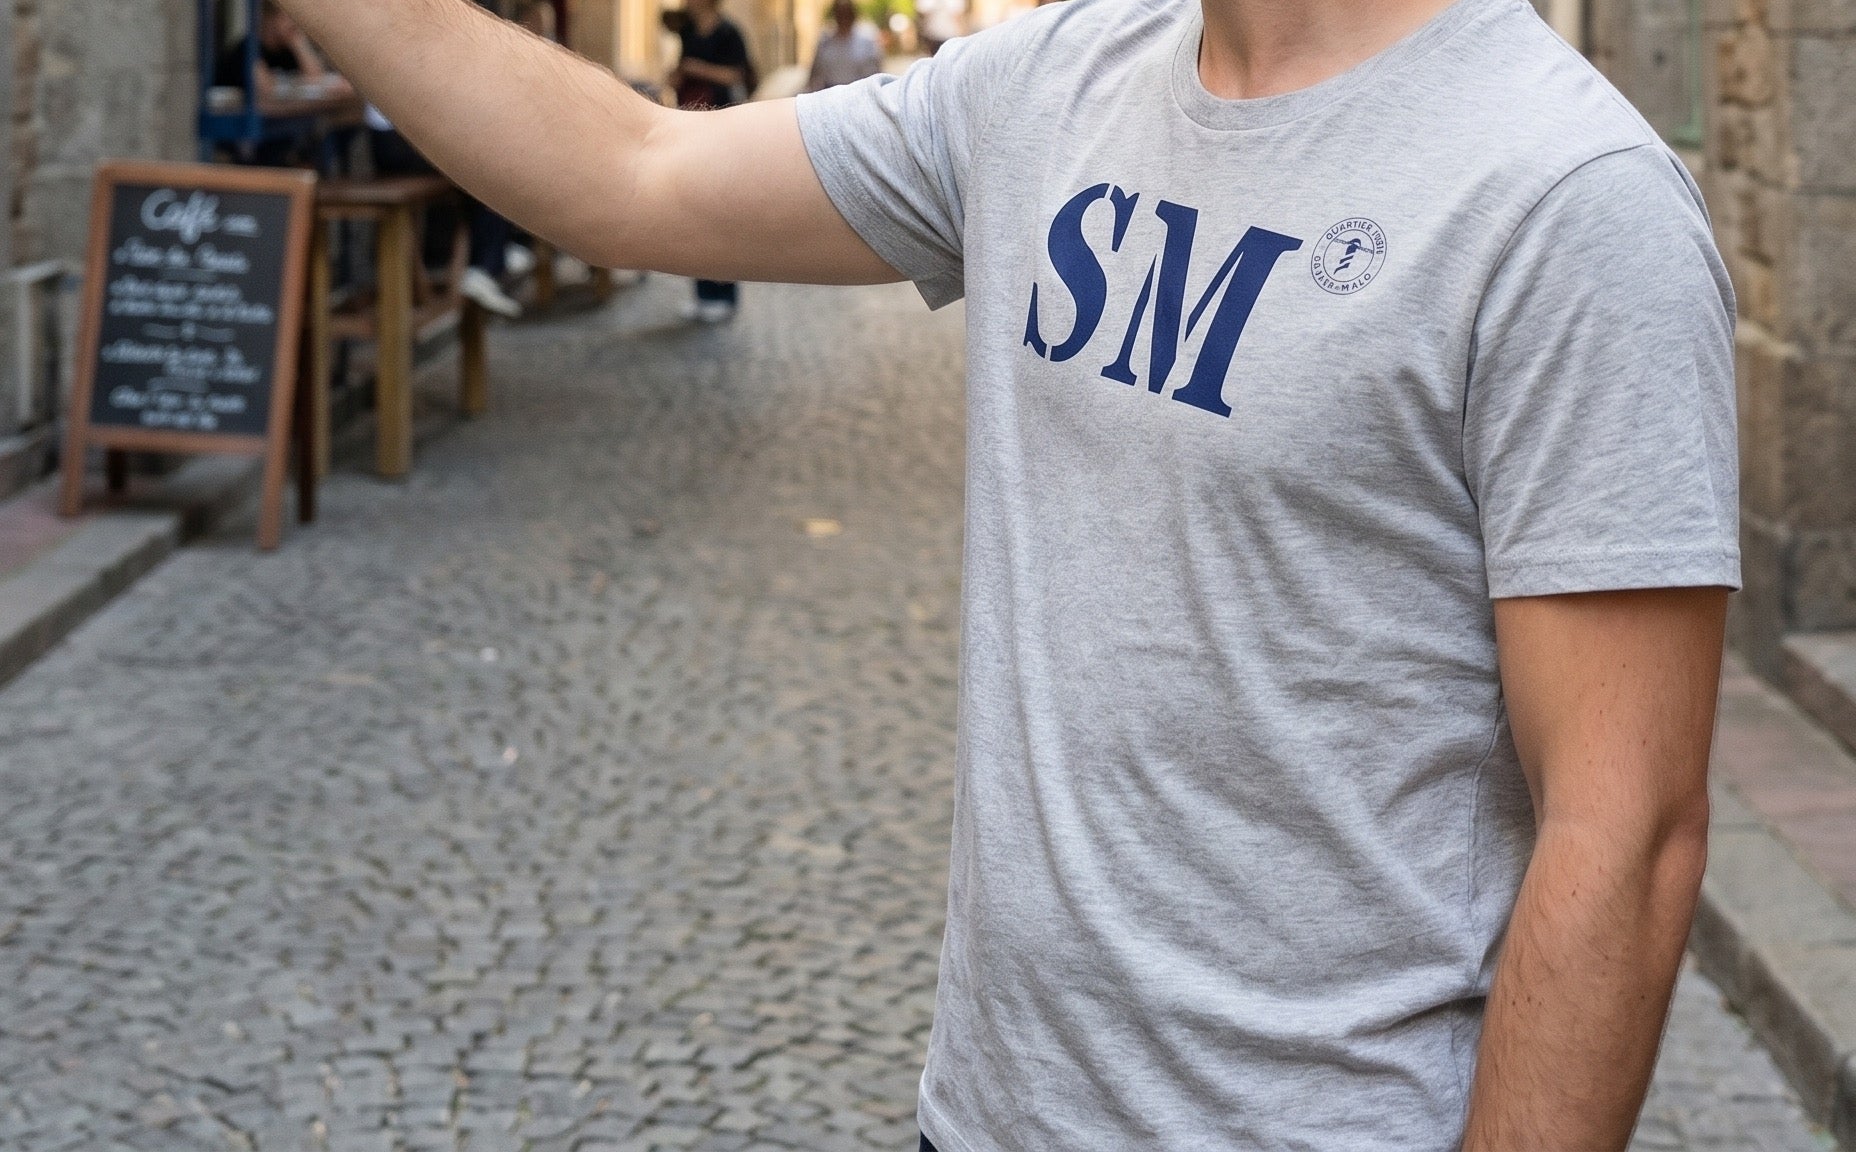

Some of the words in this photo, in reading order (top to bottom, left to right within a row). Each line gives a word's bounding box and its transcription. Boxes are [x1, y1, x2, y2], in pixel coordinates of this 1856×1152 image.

[1326, 220, 1373, 240] QUARTIER
[1341, 273, 1371, 292] MALO
[1023, 183, 1304, 418] SM
